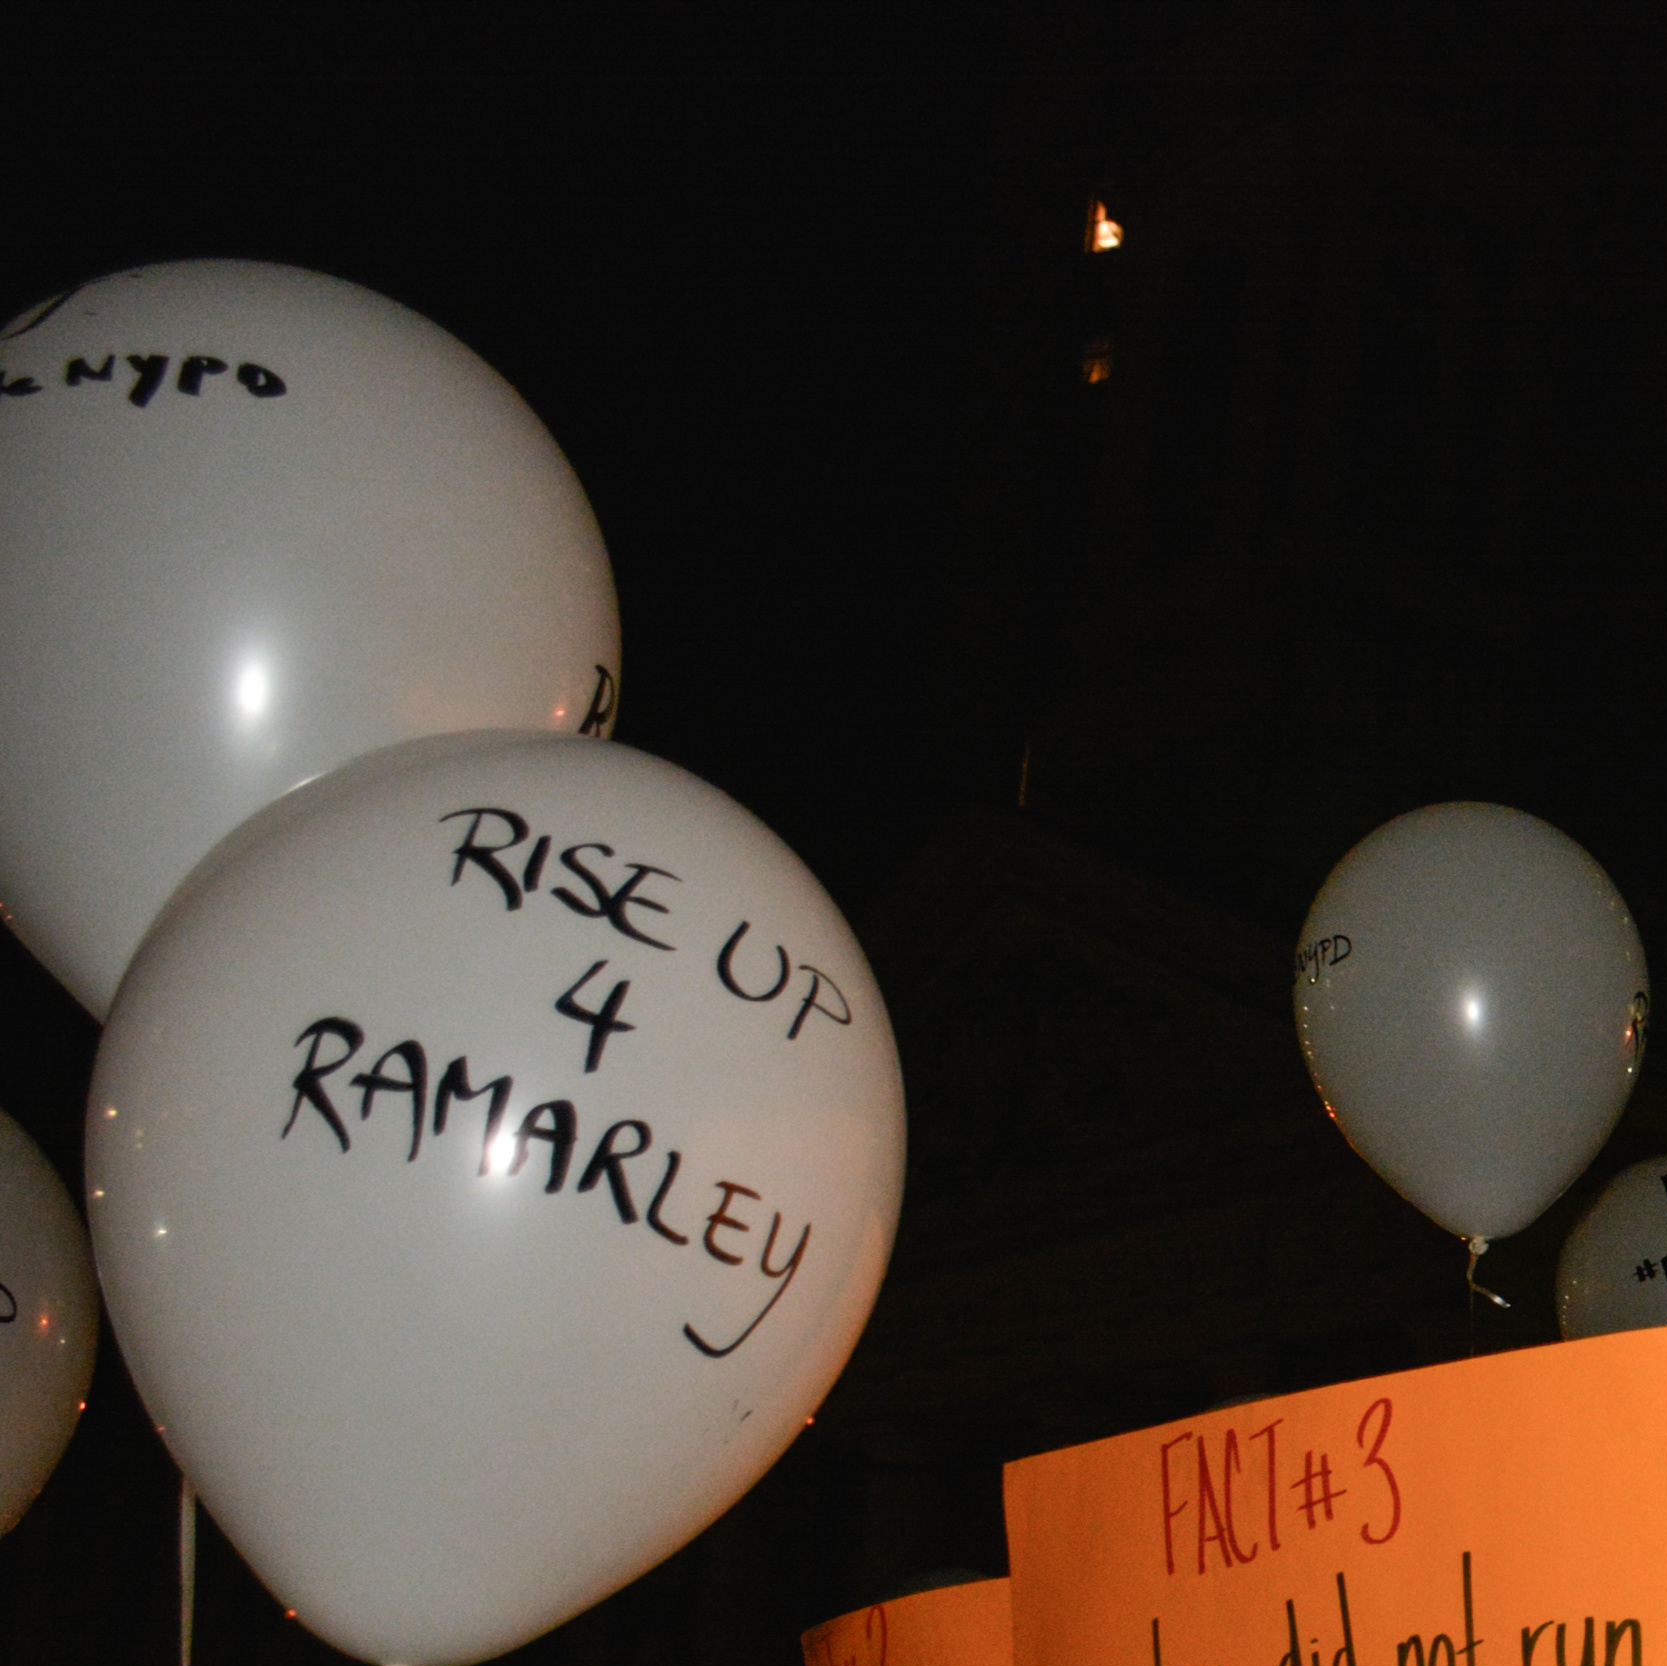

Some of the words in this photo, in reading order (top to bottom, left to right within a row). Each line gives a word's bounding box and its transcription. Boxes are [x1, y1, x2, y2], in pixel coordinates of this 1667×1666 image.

[66, 354, 287, 408] NYPD
[439, 807, 684, 951] RISE
[716, 920, 853, 1041] UP
[553, 959, 639, 1074] 4
[281, 1016, 812, 1358] RAMARLEY
